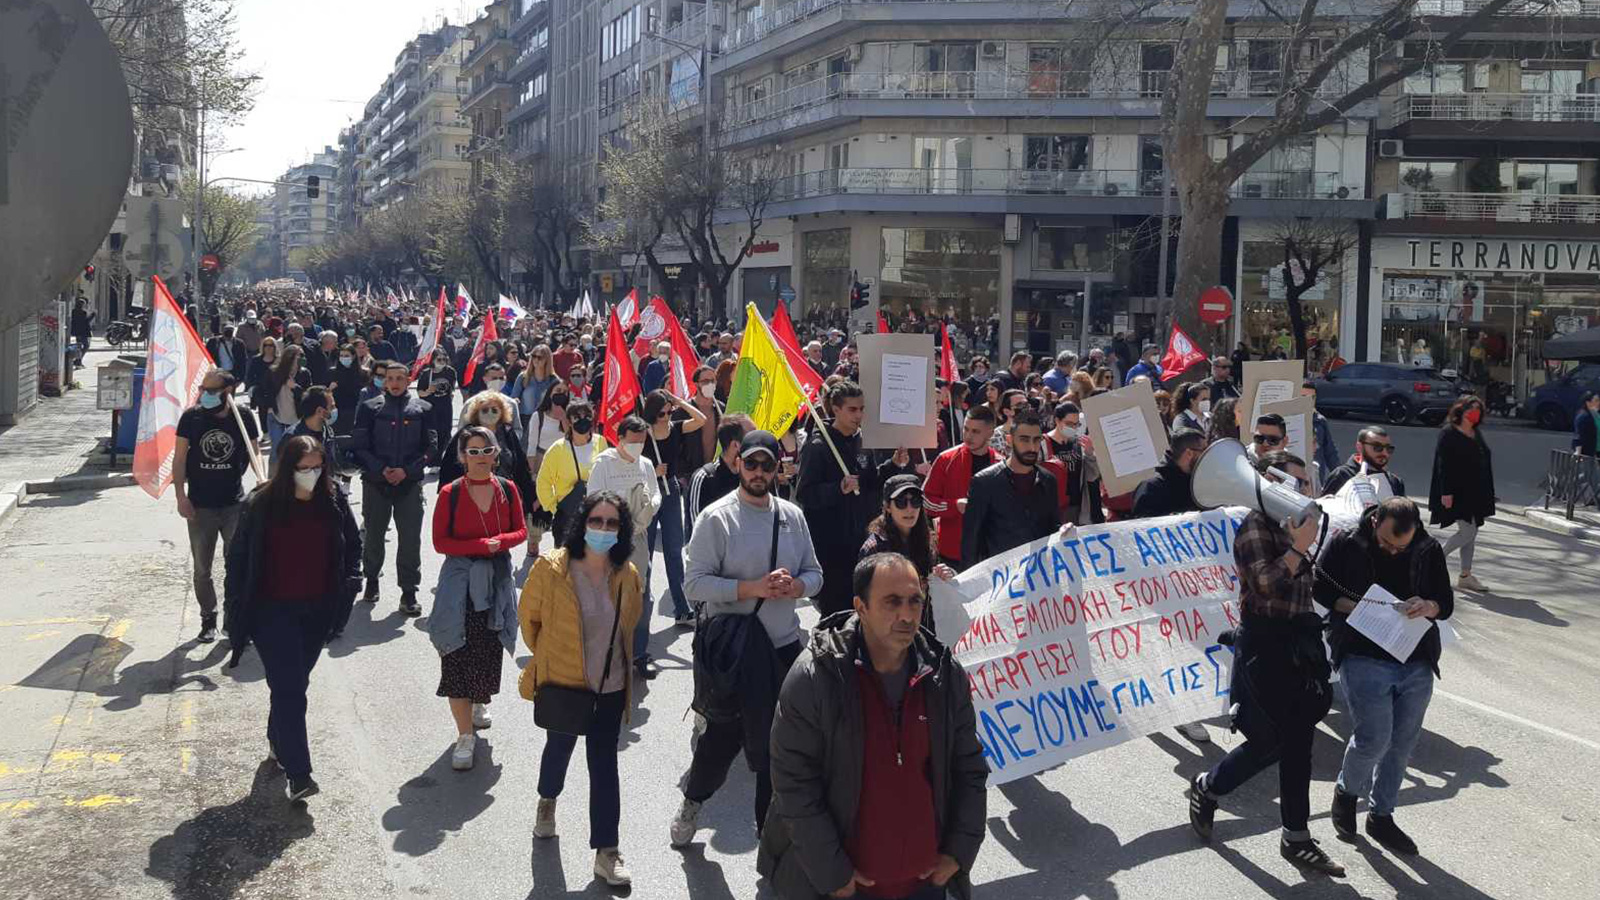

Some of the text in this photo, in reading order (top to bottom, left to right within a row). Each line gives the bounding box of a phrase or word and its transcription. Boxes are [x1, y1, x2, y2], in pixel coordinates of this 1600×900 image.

[1408, 241, 1600, 271] TERRANOVA
[1009, 533, 1125, 599] ΕΡΓΑΤΕΣ
[953, 613, 1008, 655] ΑΜΙΑ
[1011, 590, 1112, 638] ΕΜΠΛΟΚΗ
[1115, 576, 1168, 612] ΣΤΟΝ
[967, 601, 1241, 701] ΑΤΑΡΓΗΣΗ ΤΟΥ ΦΠΑ Κ
[975, 644, 1235, 770] ΑΛΕΥΟΥΜΕ ΓΙΑ ΤΙΣ Σ
